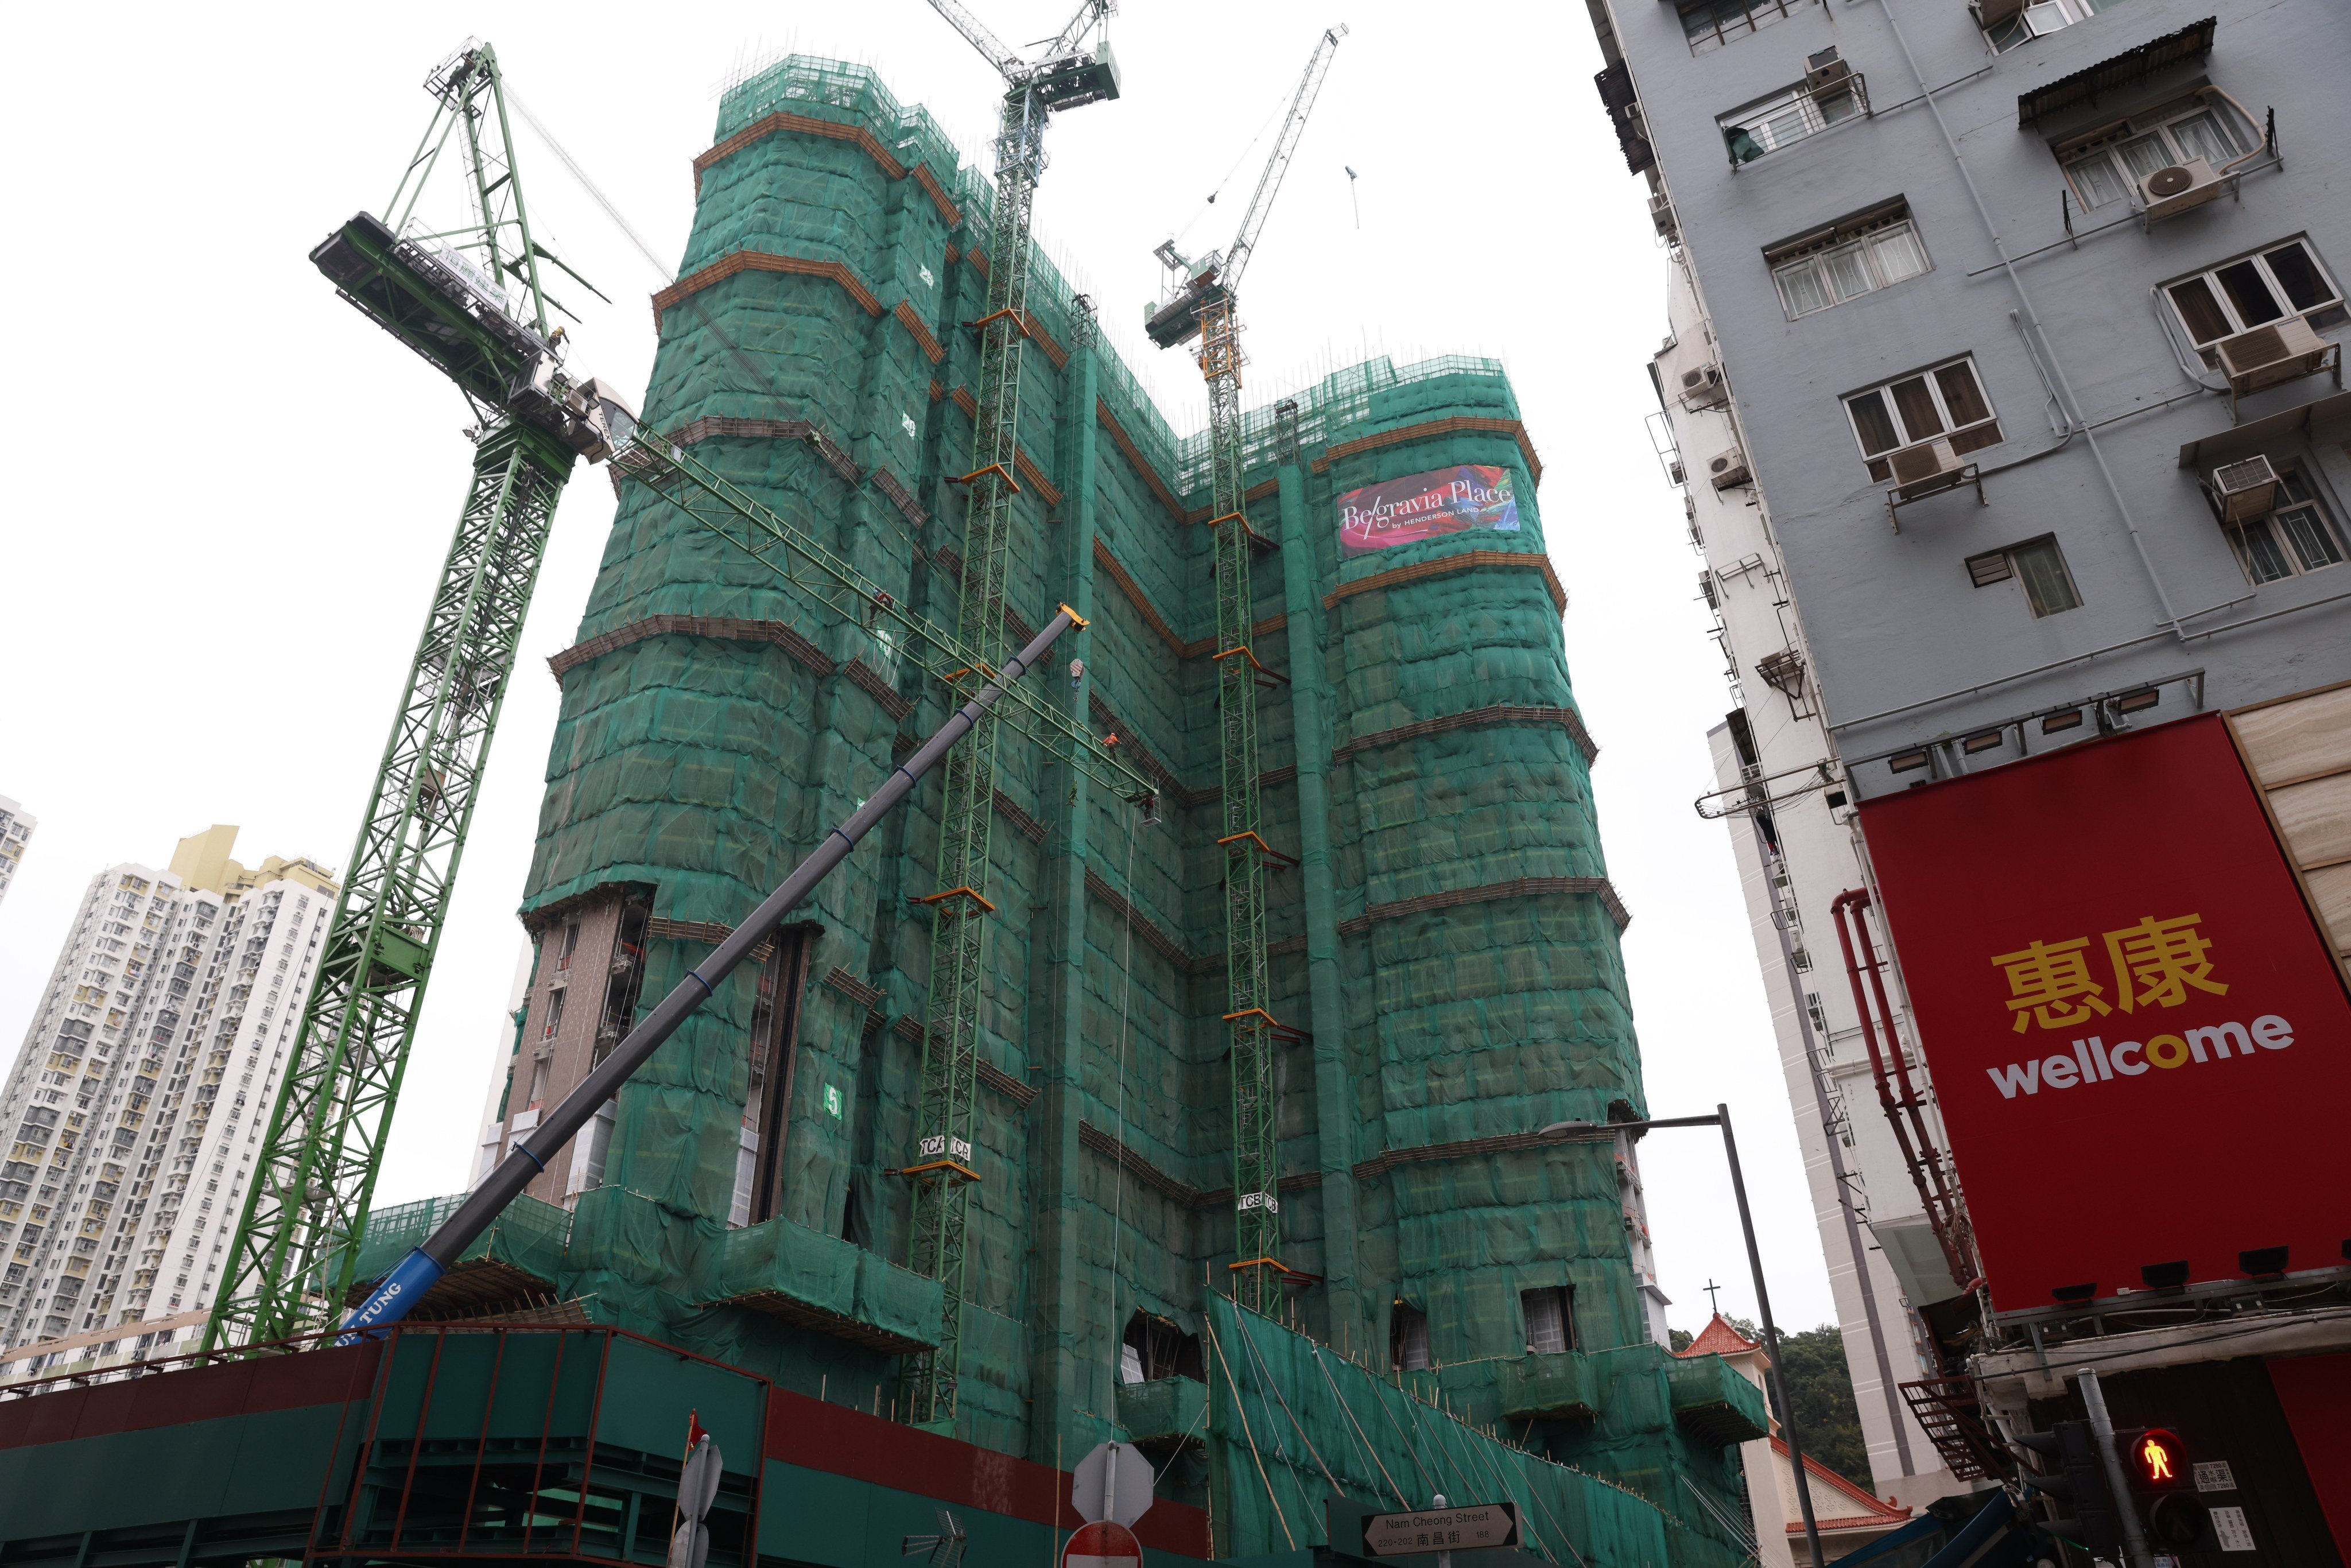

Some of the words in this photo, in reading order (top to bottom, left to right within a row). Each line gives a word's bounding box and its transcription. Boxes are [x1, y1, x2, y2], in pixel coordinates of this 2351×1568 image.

[445, 250, 505, 305] 恒麗建築
[599, 412, 611, 440] TEREX
[1343, 487, 1445, 540] Belgravia
[1448, 480, 1511, 504] Place
[1404, 510, 1454, 526] HENDERSON
[1457, 507, 1480, 515] LAND
[1991, 913, 2229, 1034] 惠康
[1986, 1014, 2295, 1099] wellcome
[828, 1086, 838, 1115] 5
[1240, 1194, 1261, 1208] TCB
[1265, 1195, 1277, 1212] TCB
[359, 1282, 401, 1324] TUNG
[2198, 1471, 2210, 1484] 通
[2216, 1469, 2228, 1483] 渠
[1386, 1519, 1409, 1530] Nam
[1413, 1515, 1452, 1528] Cheong
[1456, 1511, 1489, 1523] Street
[1378, 1538, 1413, 1547] 220-202
[1417, 1531, 1461, 1547] 南昌街
[1476, 1531, 1489, 1539] 188
